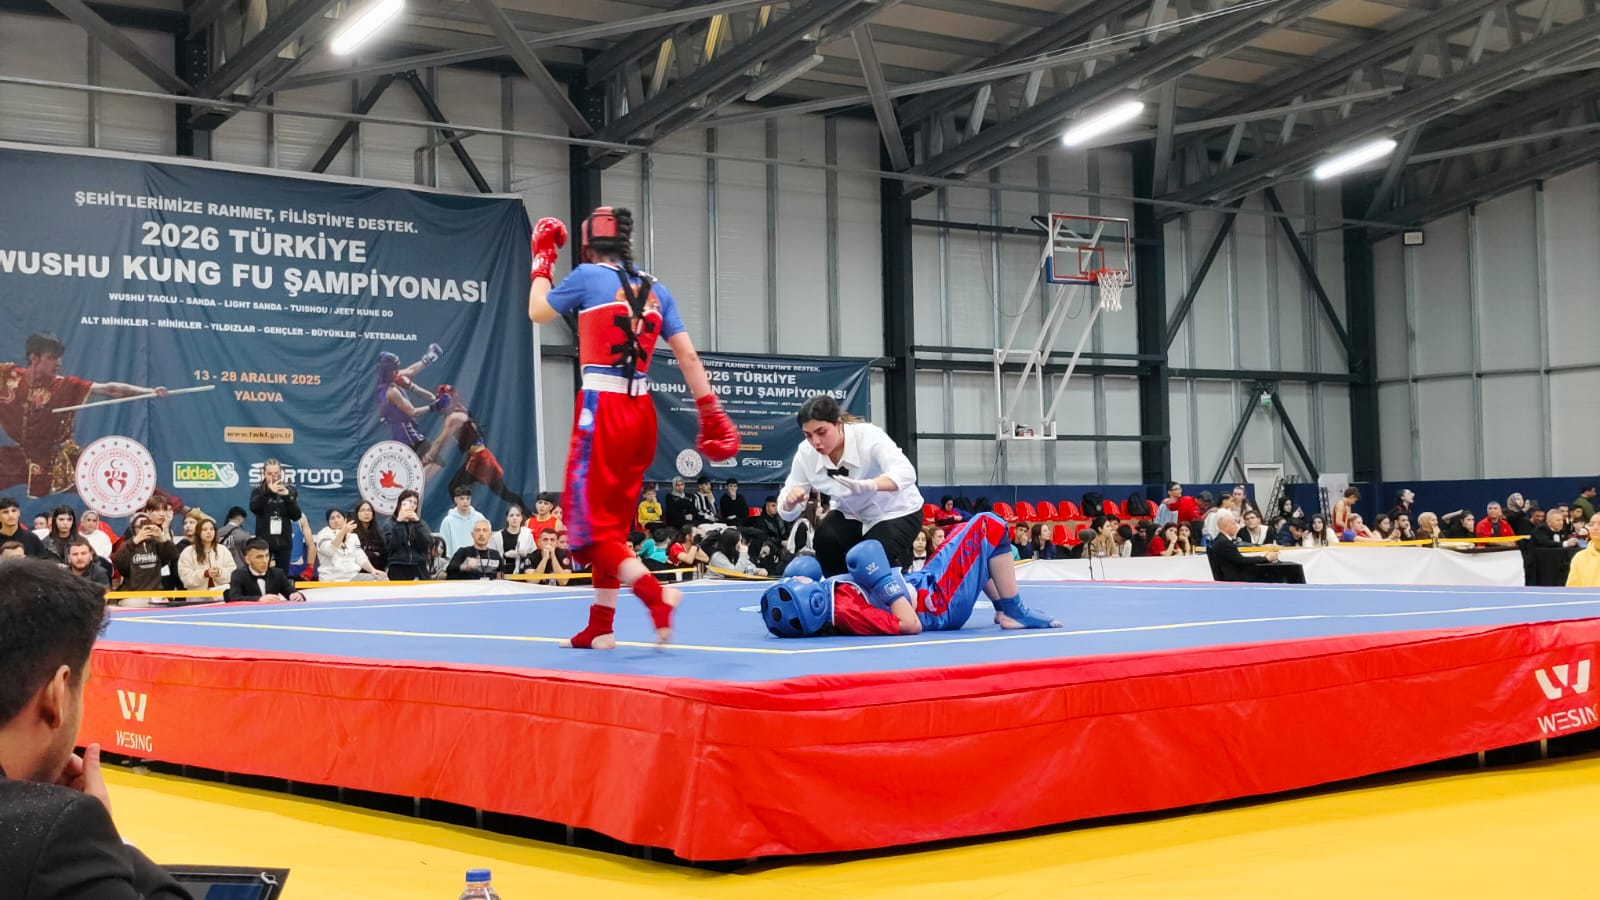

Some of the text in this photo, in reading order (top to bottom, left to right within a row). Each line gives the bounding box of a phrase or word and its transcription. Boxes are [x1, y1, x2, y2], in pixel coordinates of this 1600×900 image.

[75, 191, 203, 214] ŞEHİTLERİMİZE
[208, 203, 275, 223] RAHMET,
[358, 217, 419, 234] DESTEK.
[142, 221, 367, 264] 2026 TÜRKİYE
[123, 254, 221, 286] KUNG
[232, 264, 273, 290] FU
[284, 268, 488, 304] ŞAMPİYONASI
[109, 292, 145, 302] WUSHU
[147, 294, 178, 304] TAOLU
[186, 297, 216, 307] SANDA
[224, 299, 251, 309] LIGHT
[253, 302, 282, 311] SANDA
[290, 304, 328, 314] TUISHOU
[334, 306, 355, 315] JEET
[357, 308, 380, 317] KUNE
[382, 310, 394, 318] DO
[81, 316, 99, 325] ALT
[102, 316, 149, 327] MİNİKLER
[158, 318, 202, 330] MİNİKLER
[210, 323, 256, 333] YILDIZLAR
[264, 326, 304, 337] GENÇLER
[311, 328, 356, 339] BÜYÜKLER
[364, 332, 418, 342] VETERANLAR
[194, 369, 210, 380] 13
[221, 371, 237, 382] 28
[240, 372, 288, 384] ARALIK
[291, 374, 321, 385] 2025
[705, 370, 796, 385] 026 TÜRKİYE
[234, 390, 283, 403] YALOVA
[736, 386, 754, 396] FU
[176, 465, 344, 483] iddaa SRTOTO
[115, 729, 153, 753] WESING
